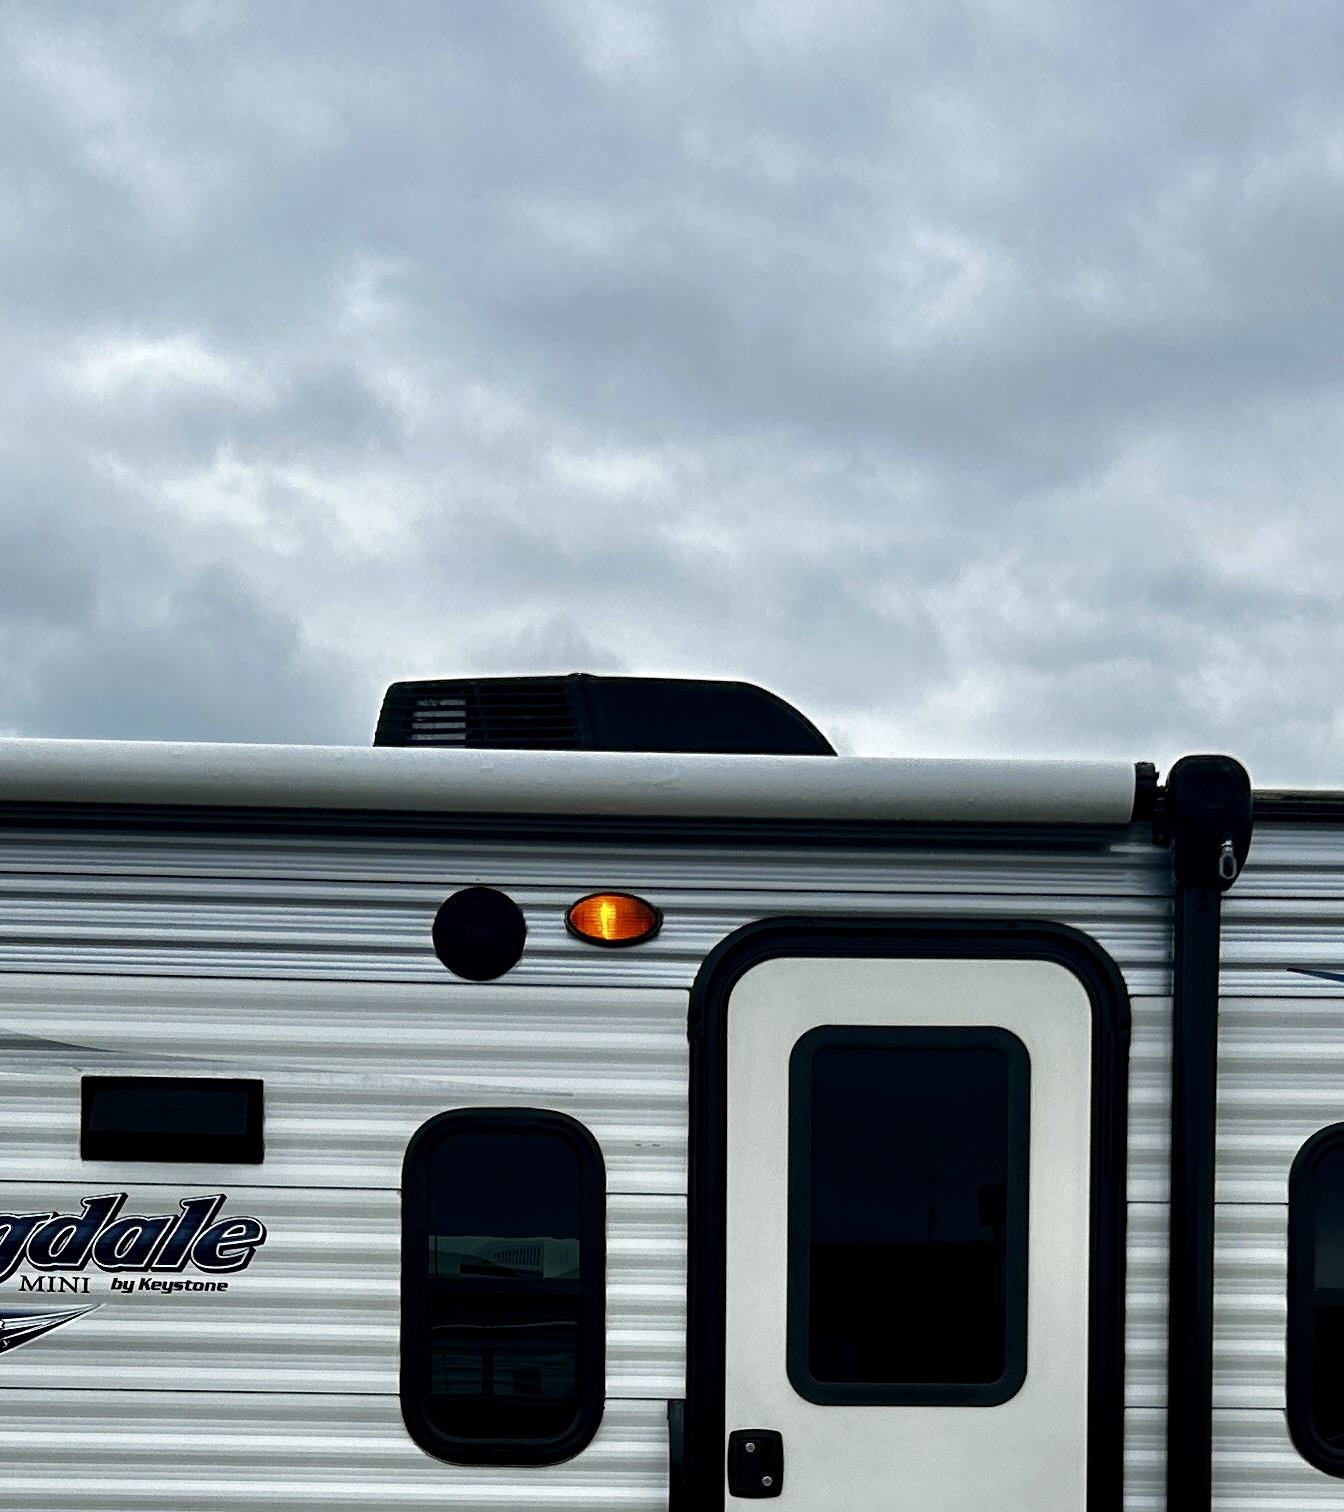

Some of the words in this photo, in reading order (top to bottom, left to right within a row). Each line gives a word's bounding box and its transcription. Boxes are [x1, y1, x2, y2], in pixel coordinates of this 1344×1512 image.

[18, 1275, 91, 1294] MINI
[110, 1277, 136, 1293] by
[138, 1277, 229, 1294] Keystone
